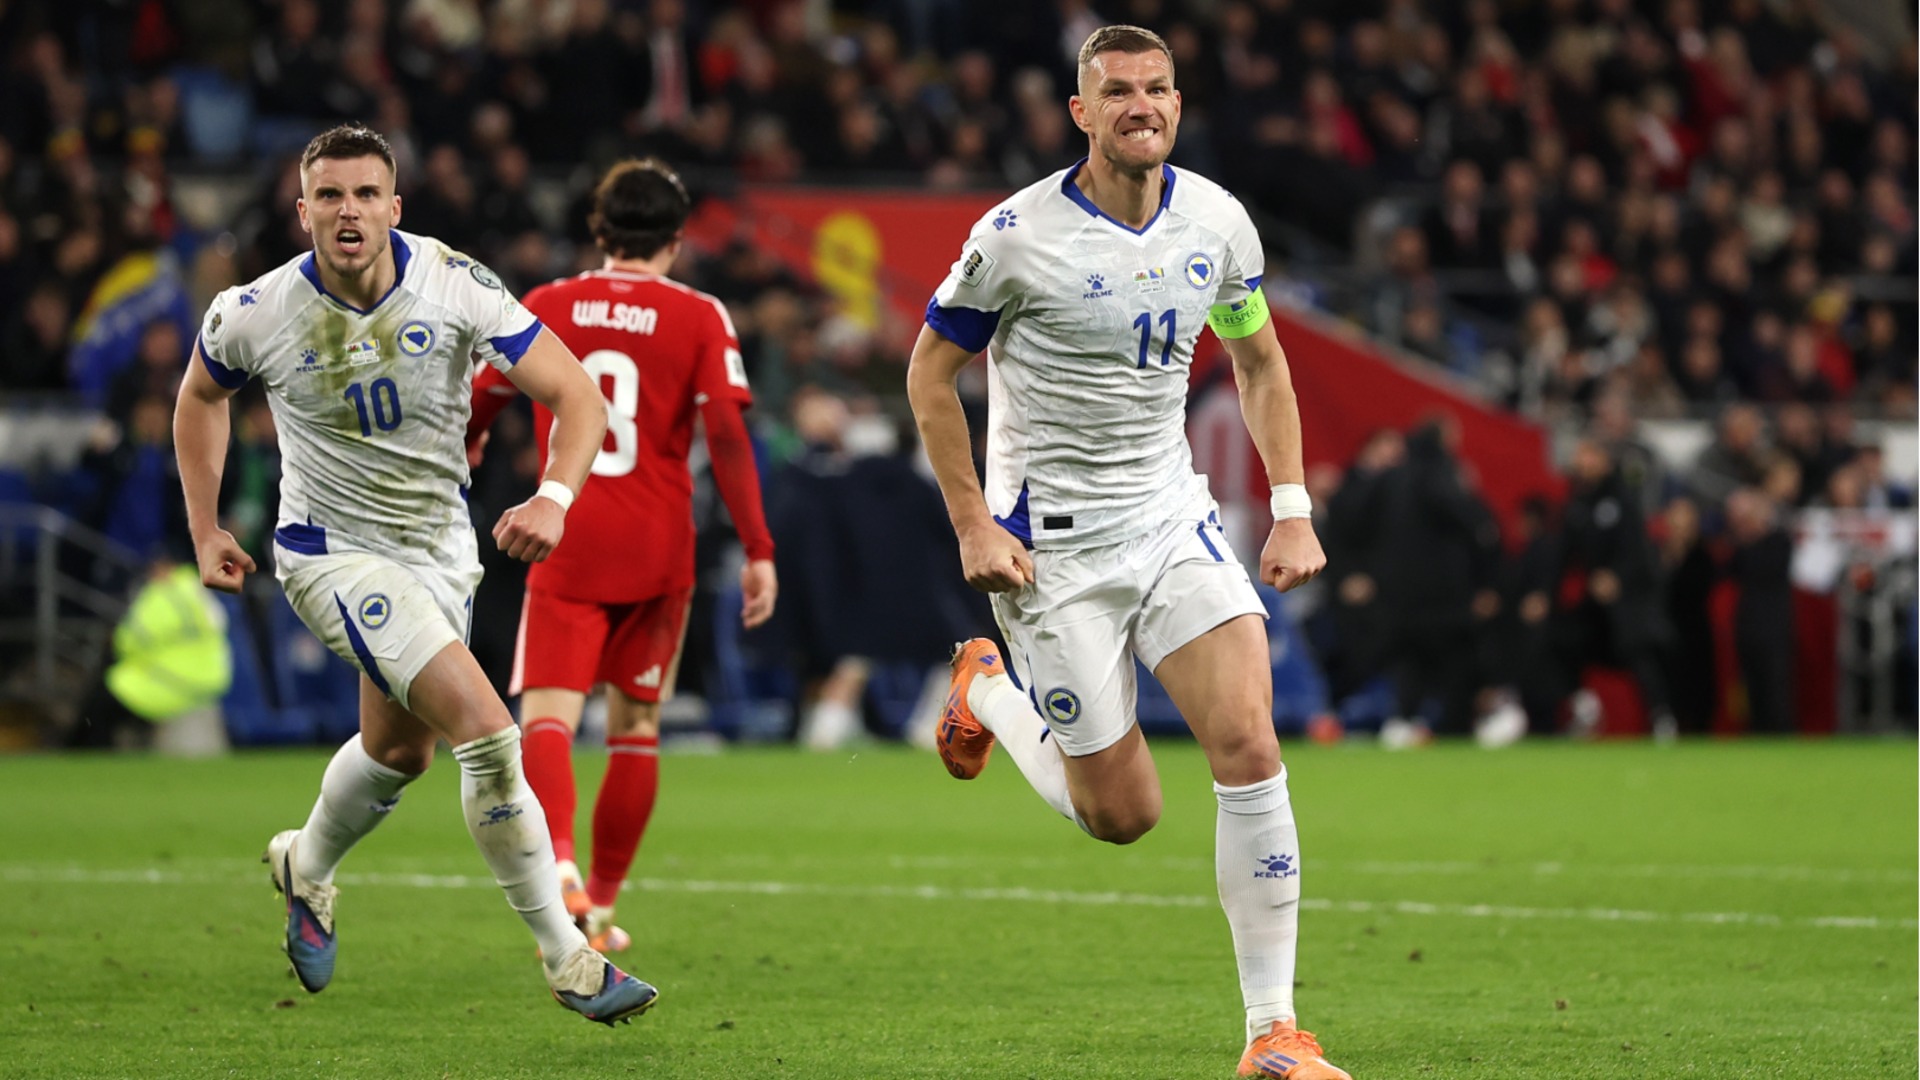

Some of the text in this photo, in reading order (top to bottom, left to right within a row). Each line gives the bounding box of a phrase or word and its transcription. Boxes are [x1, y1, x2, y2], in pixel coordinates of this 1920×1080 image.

[1083, 289, 1113, 299] KELME
[572, 299, 658, 336] WILSON
[1223, 302, 1260, 325] RESPECT
[1133, 308, 1177, 370] 11
[296, 364, 326, 373] KELME
[344, 377, 403, 437] 10
[581, 349, 640, 477] 8
[1254, 868, 1297, 878] KELME
